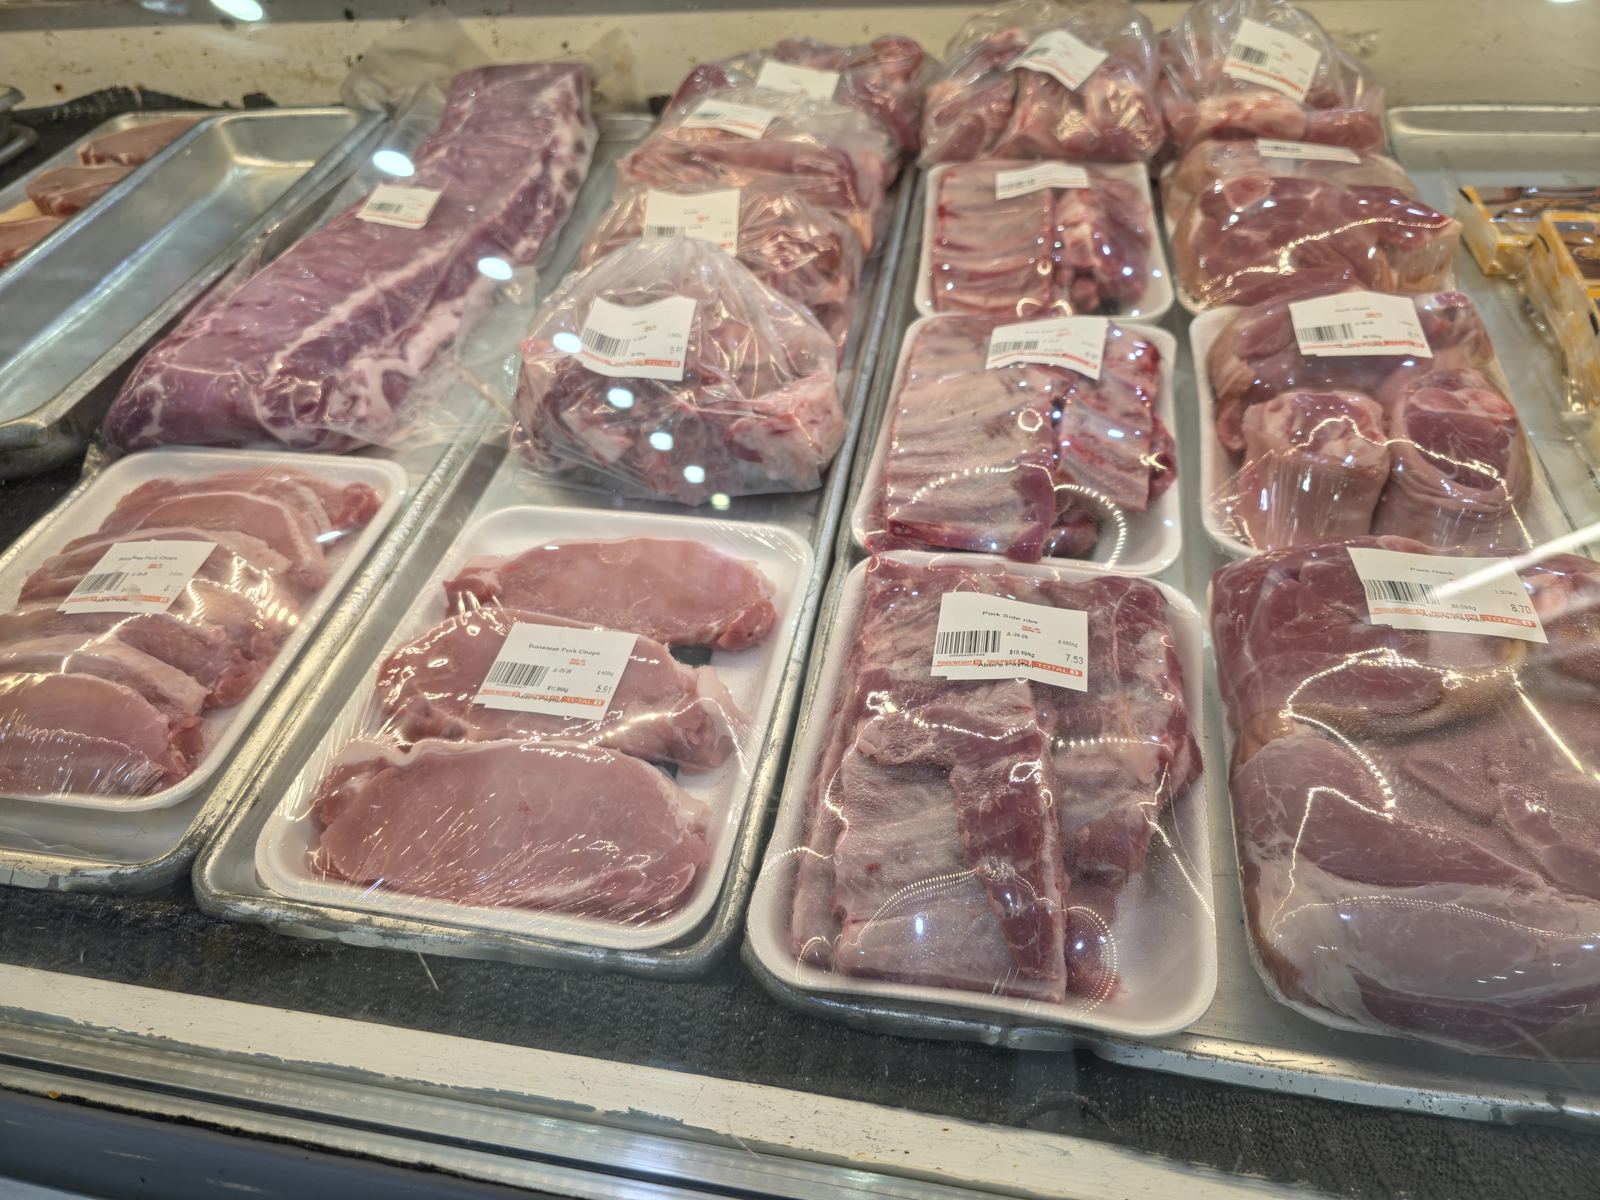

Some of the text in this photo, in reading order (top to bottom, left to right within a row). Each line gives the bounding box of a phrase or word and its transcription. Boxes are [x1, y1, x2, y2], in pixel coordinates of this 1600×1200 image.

[1510, 603, 1532, 615] 8.70
[1065, 653, 1084, 665] 7.53
[1038, 664, 1067, 673] TOTAL
[595, 685, 612, 694] 5.91
